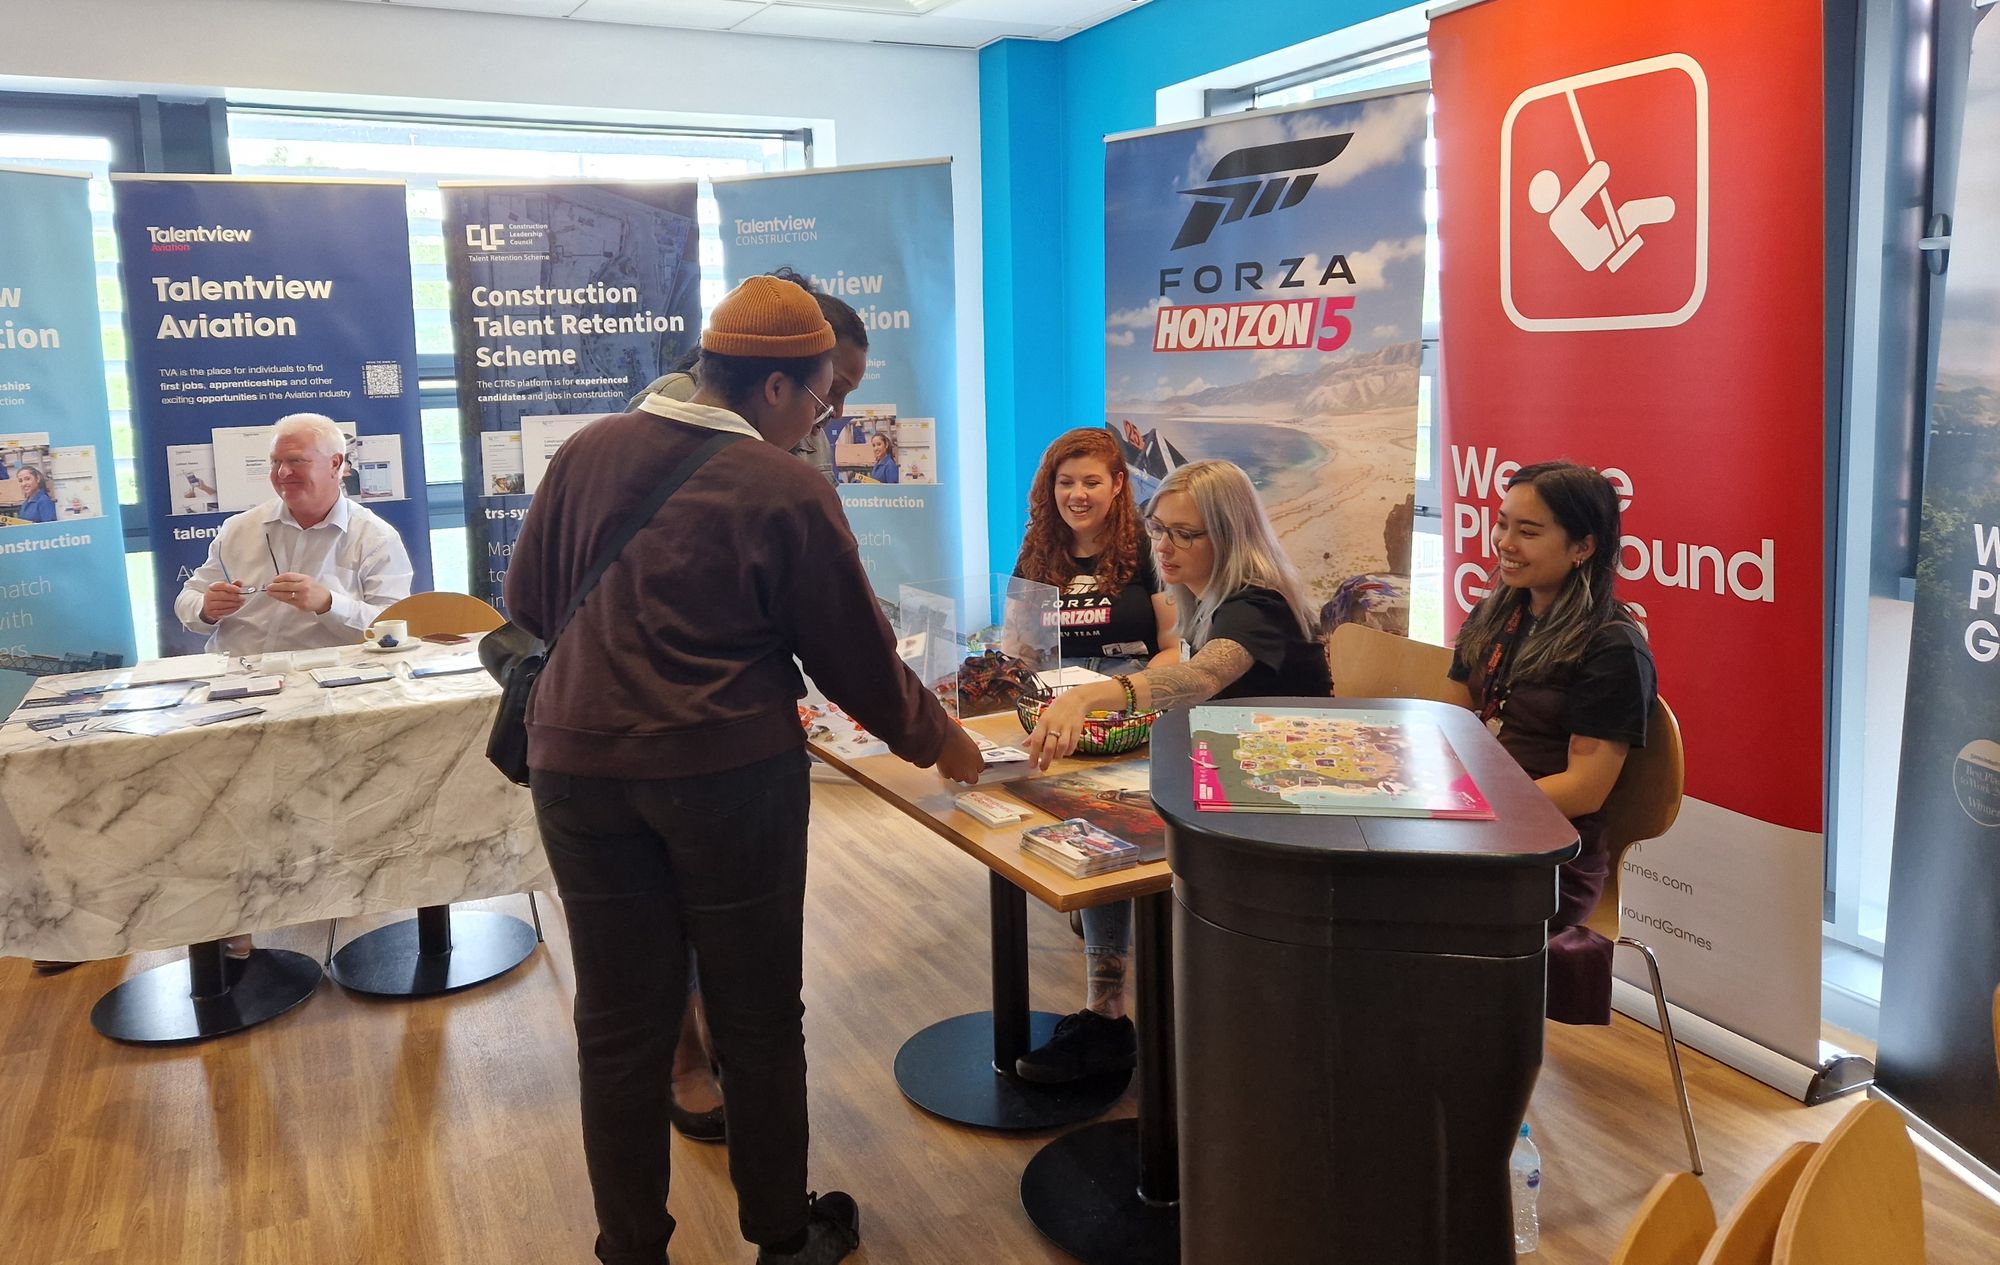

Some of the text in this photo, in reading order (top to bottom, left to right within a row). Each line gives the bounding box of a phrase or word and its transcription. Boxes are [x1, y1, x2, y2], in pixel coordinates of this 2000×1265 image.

[508, 223, 549, 231] Construction
[735, 214, 816, 235] Talentview
[146, 225, 252, 243] Talentview
[735, 231, 818, 246] CONSTRUCTION
[152, 244, 190, 253] Aviation
[468, 254, 489, 262] Talent
[490, 253, 523, 261] Retention
[1159, 254, 1356, 296] FORZA
[151, 274, 333, 302] Talentview
[471, 282, 637, 308] Construction
[156, 312, 297, 340] Aviation
[473, 311, 685, 337] Talent Retention
[1155, 296, 1356, 352] HORIZON 5
[475, 344, 577, 368] Scheme
[160, 363, 324, 377] TVA is the place for individuals to find
[160, 376, 334, 392] first jobs, apprenticeships and other
[476, 375, 629, 389] The CTRS platform is for experienced
[161, 388, 352, 405] exciting opportunities in the Aviation industry
[477, 388, 624, 402] candidates and jobs in construction
[1041, 597, 1112, 609] FORZA
[1042, 609, 1107, 626] HORIZON
